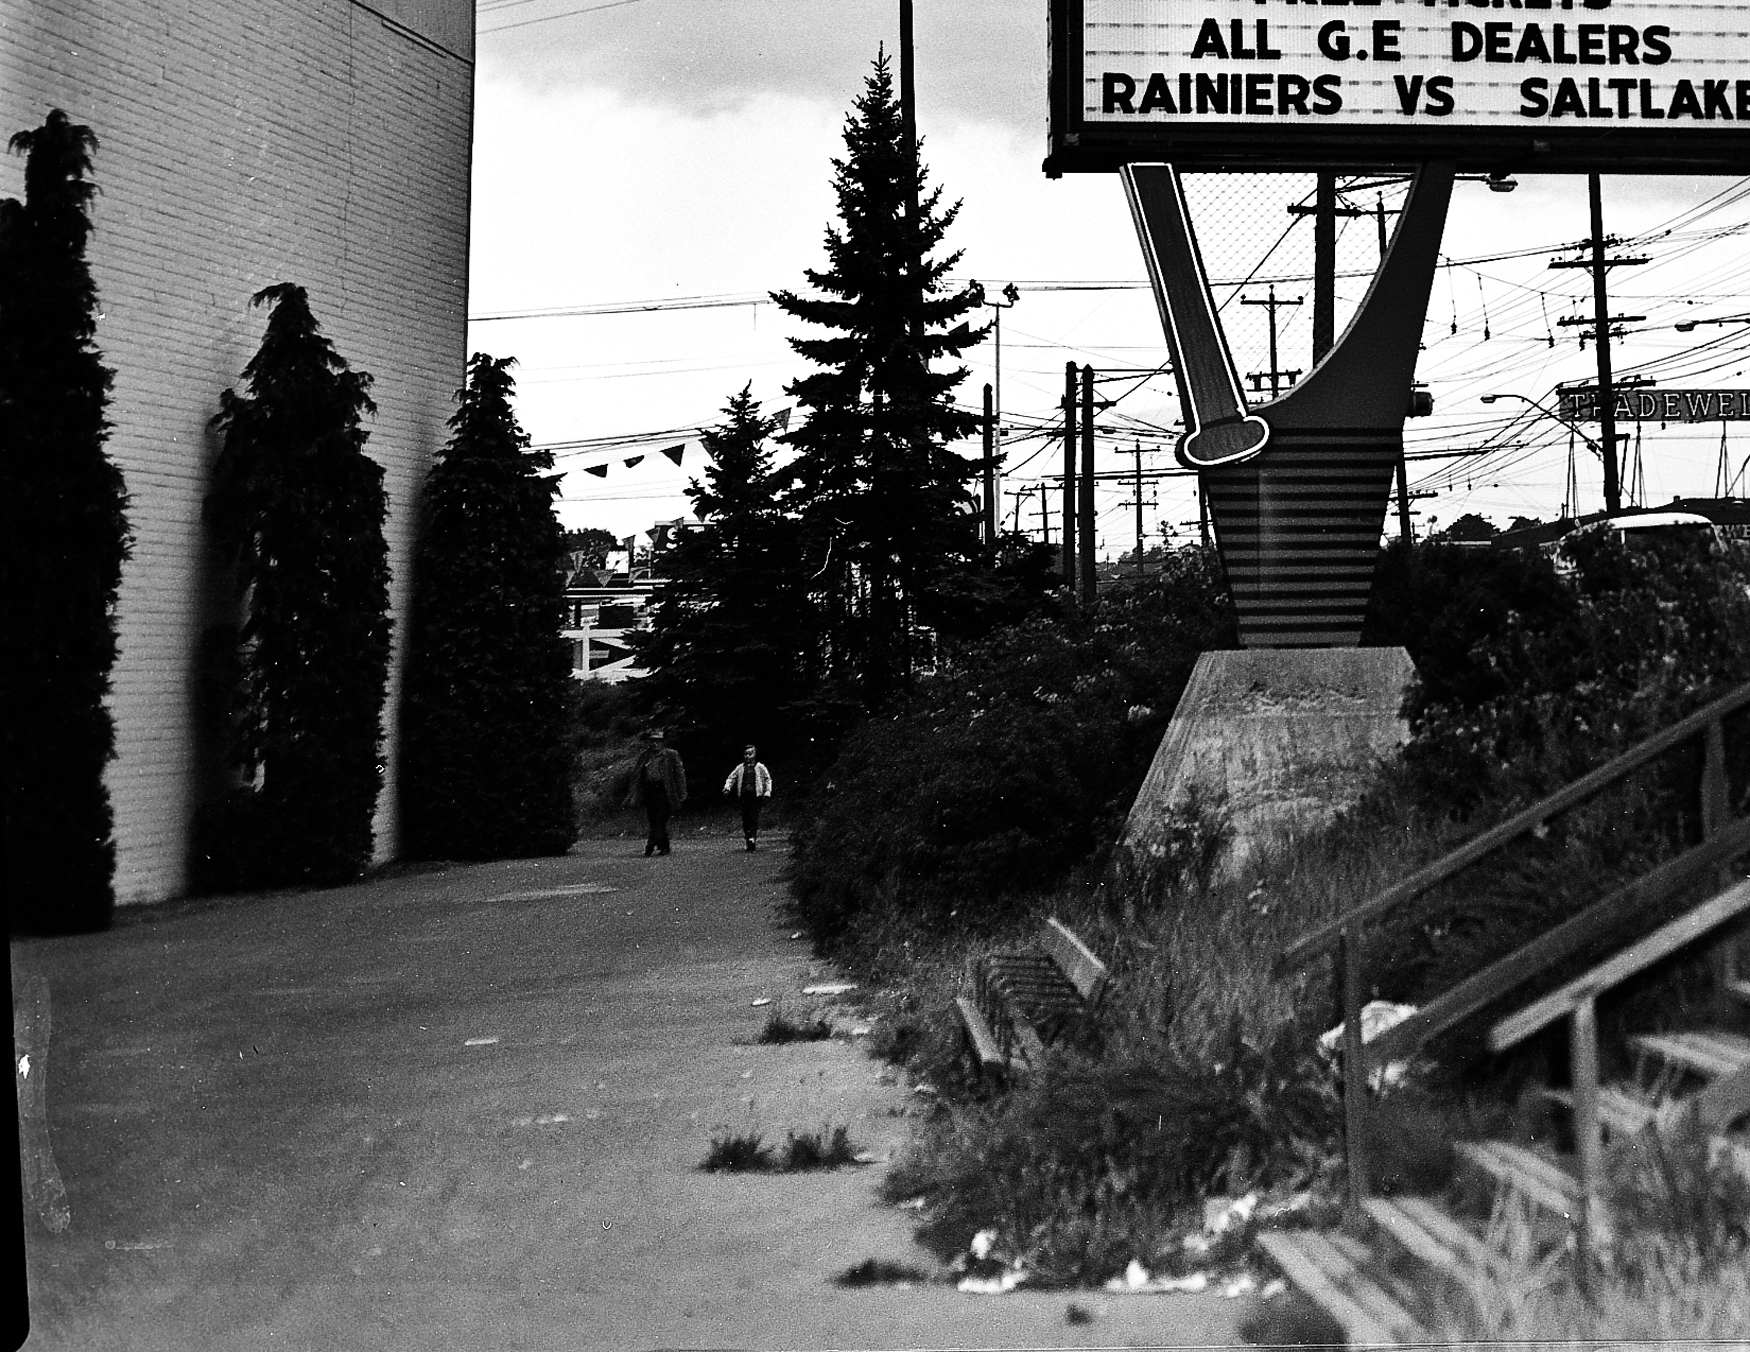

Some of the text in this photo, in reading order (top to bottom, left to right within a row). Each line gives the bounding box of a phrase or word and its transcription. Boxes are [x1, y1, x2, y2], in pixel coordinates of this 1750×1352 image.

[1190, 18, 1672, 65] ALL G.E DEALERS
[1102, 72, 1343, 116] RAINIERS
[1393, 75, 1455, 117] VS
